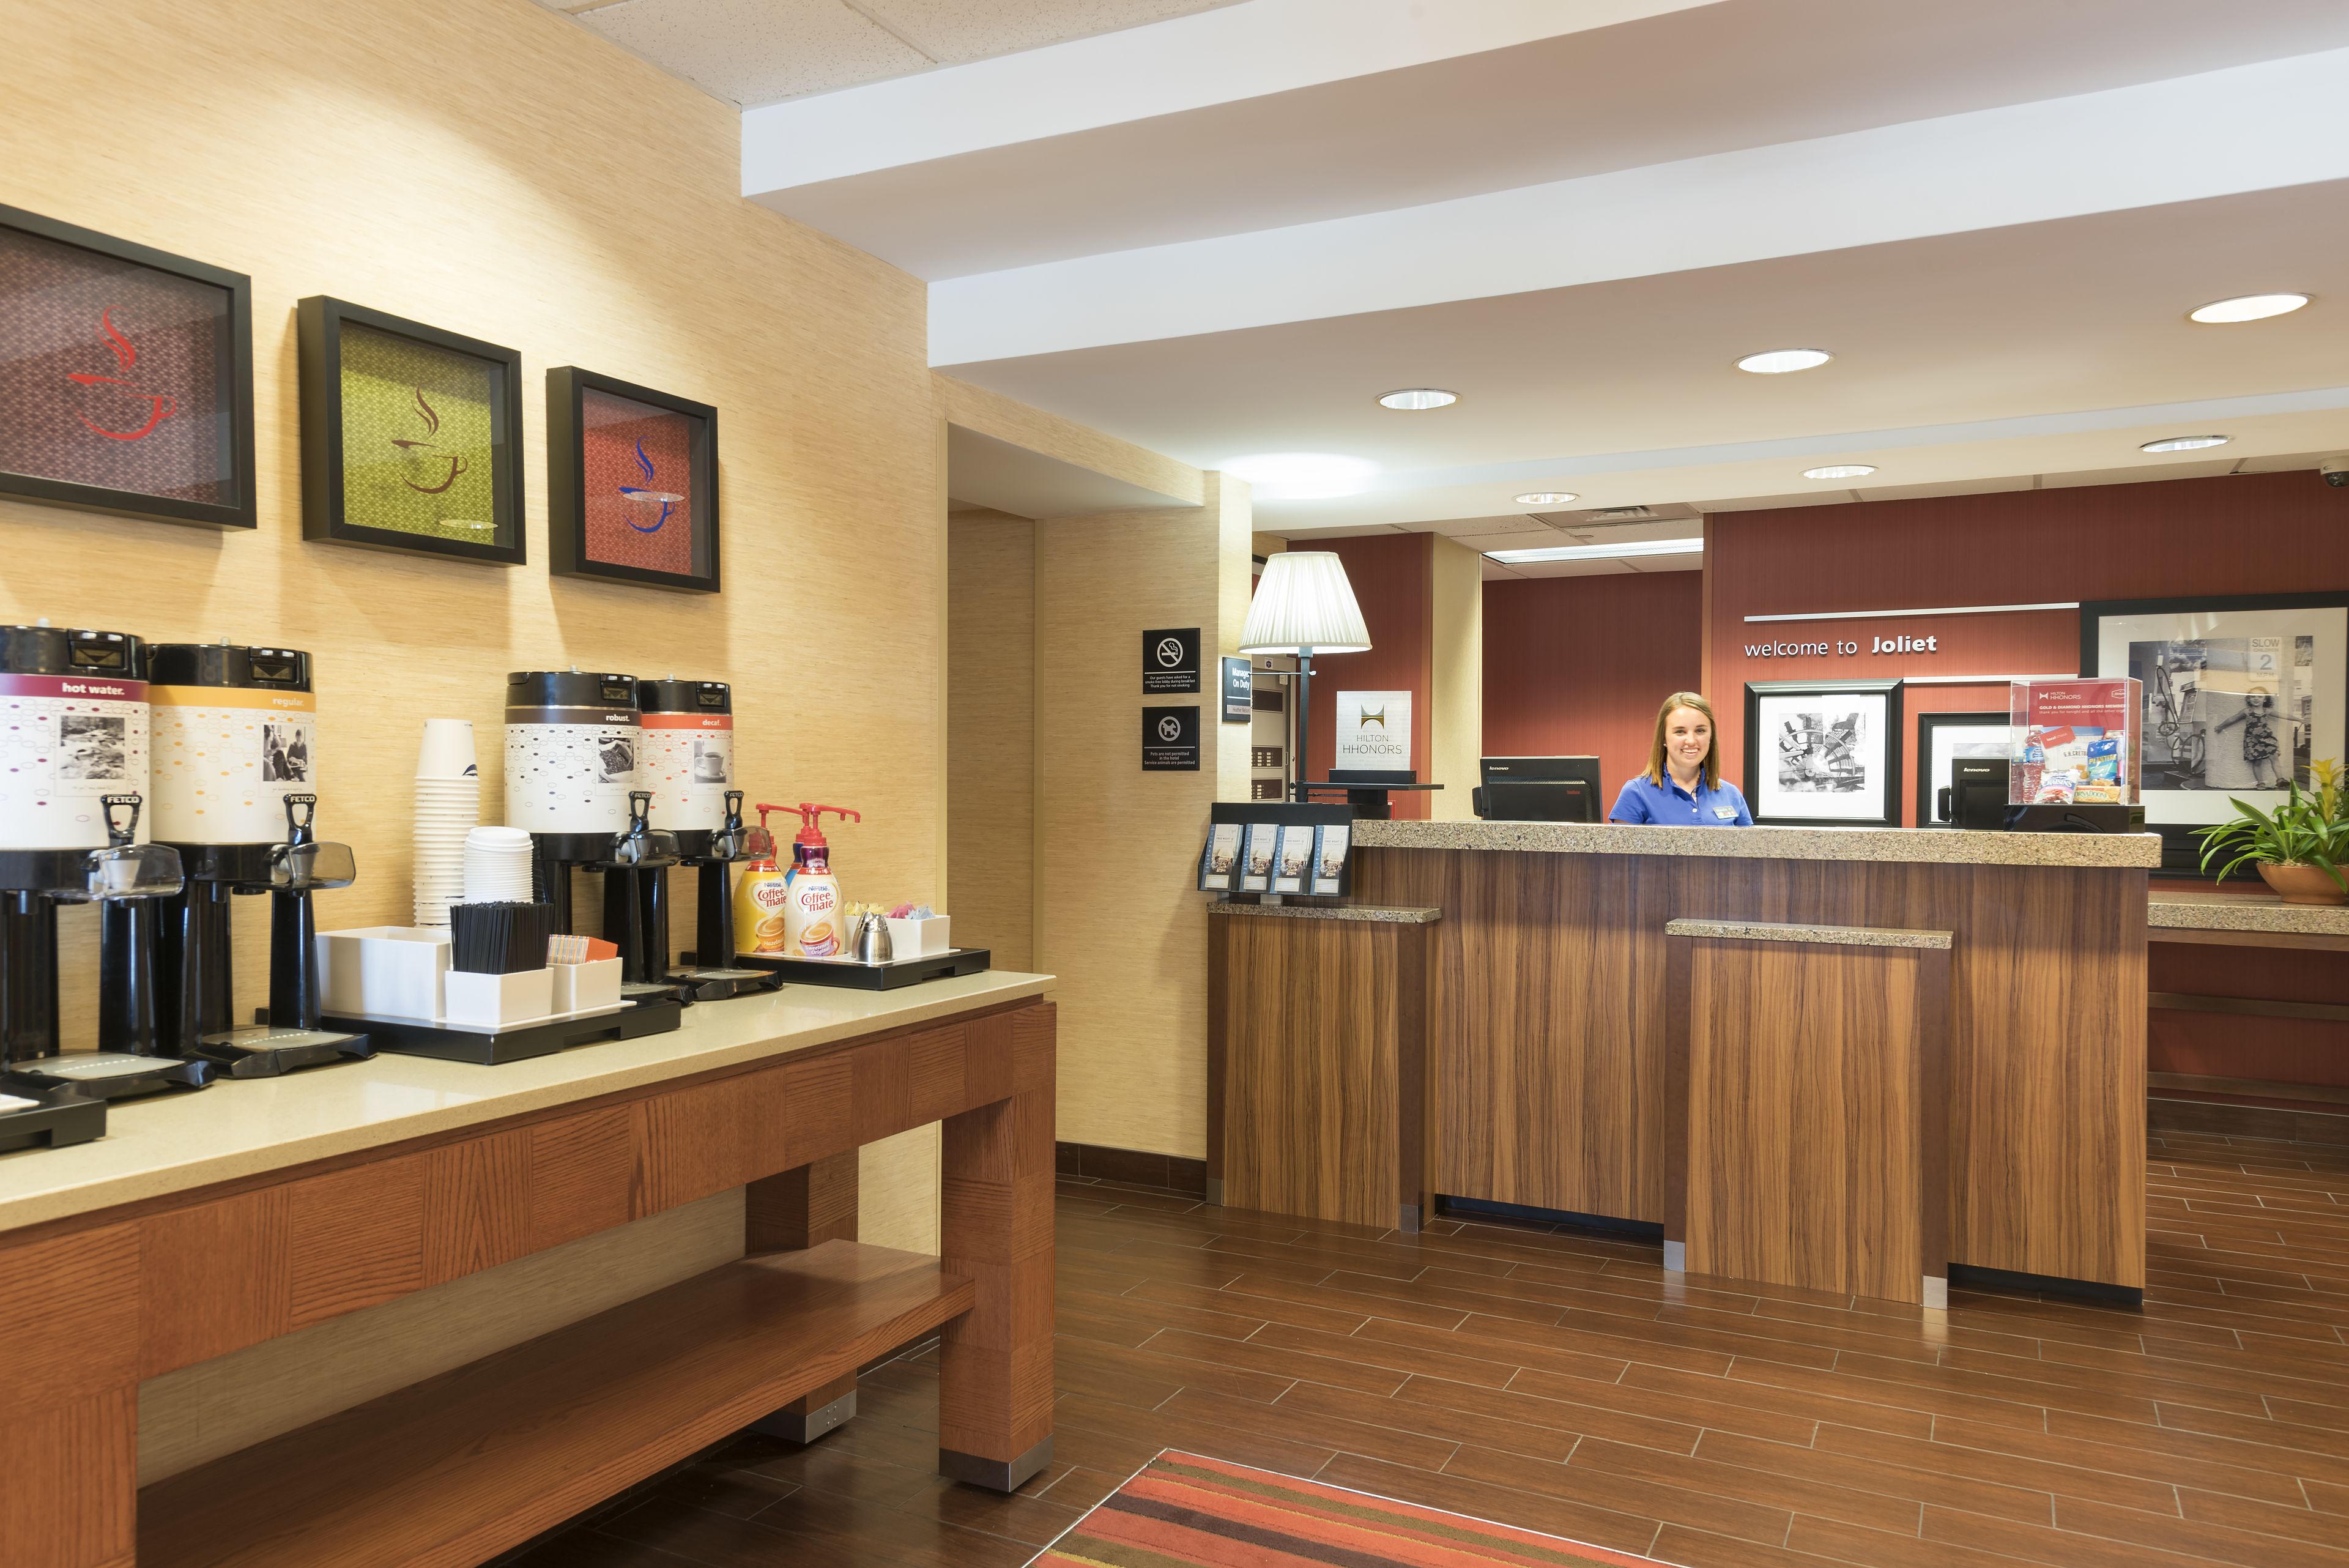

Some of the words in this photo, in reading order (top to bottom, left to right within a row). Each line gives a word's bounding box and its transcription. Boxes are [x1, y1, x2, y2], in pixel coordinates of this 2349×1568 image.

[1745, 640, 1828, 656] welcome
[1836, 640, 1857, 655] to
[1872, 636, 1937, 653] Joliet
[2252, 639, 2280, 647] SLOW
[2260, 654, 2272, 671] 2
[62, 682, 87, 693] hot
[89, 686, 125, 696] water.
[1233, 679, 1239, 688] On
[1240, 680, 1250, 691] Duty
[273, 697, 305, 707] regular.
[1343, 745, 1402, 754] HHONORS
[766, 896, 787, 907] mate
[809, 900, 833, 912] mate
[811, 946, 830, 955] Original
